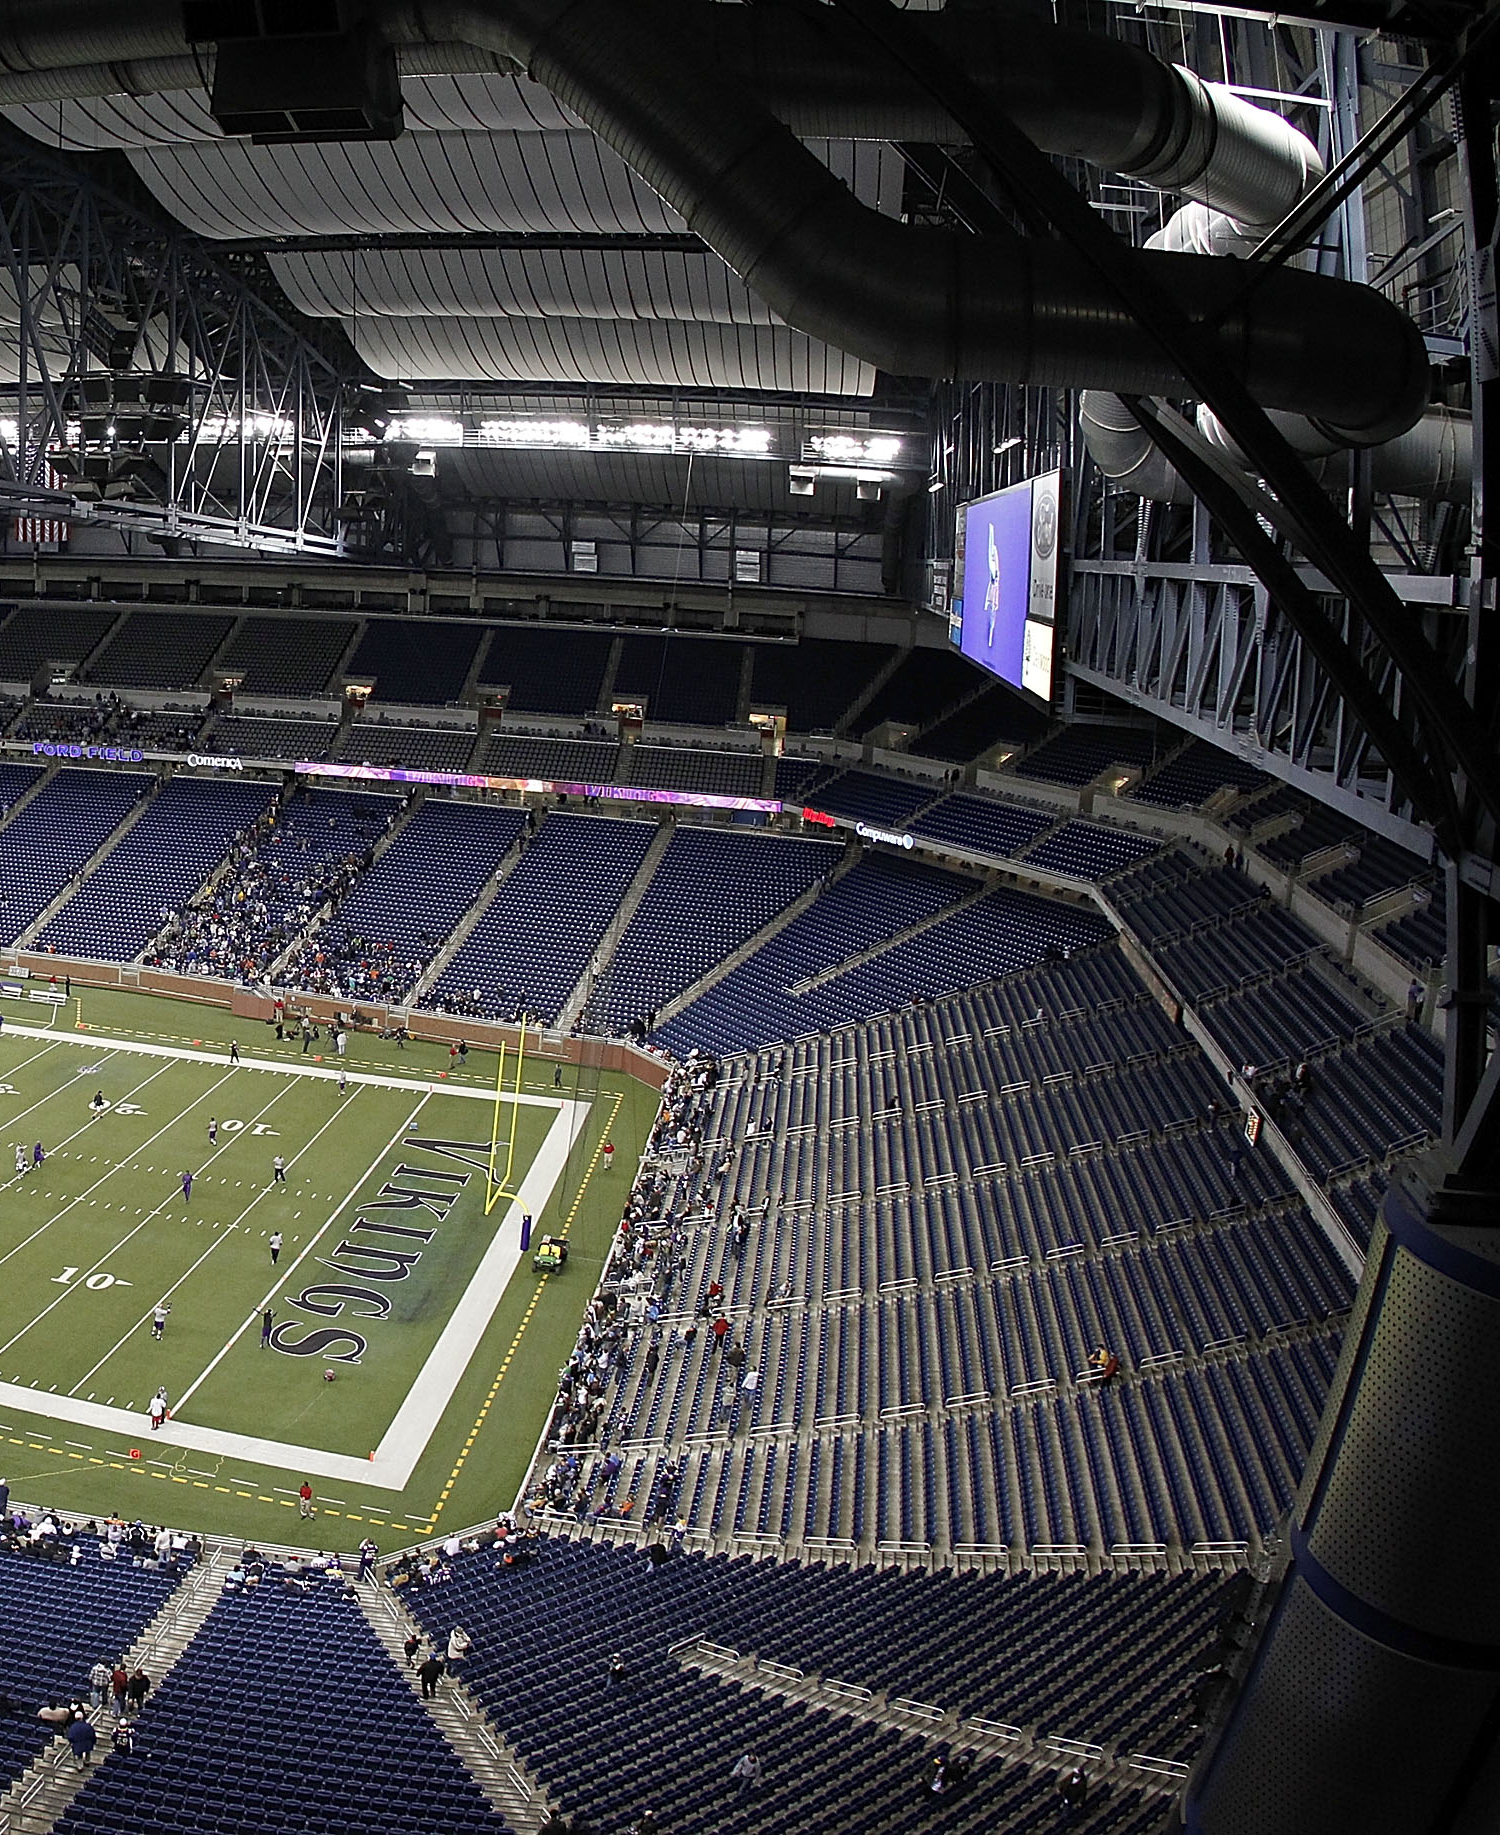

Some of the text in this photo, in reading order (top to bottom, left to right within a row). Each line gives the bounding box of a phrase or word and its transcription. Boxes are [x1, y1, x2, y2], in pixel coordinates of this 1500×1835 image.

[32, 742, 143, 762] FORD FIELD
[855, 822, 904, 846] Compuware
[220, 1119, 272, 1136] 10
[268, 1136, 513, 1365] VIKINGS
[50, 1266, 116, 1290] 10
